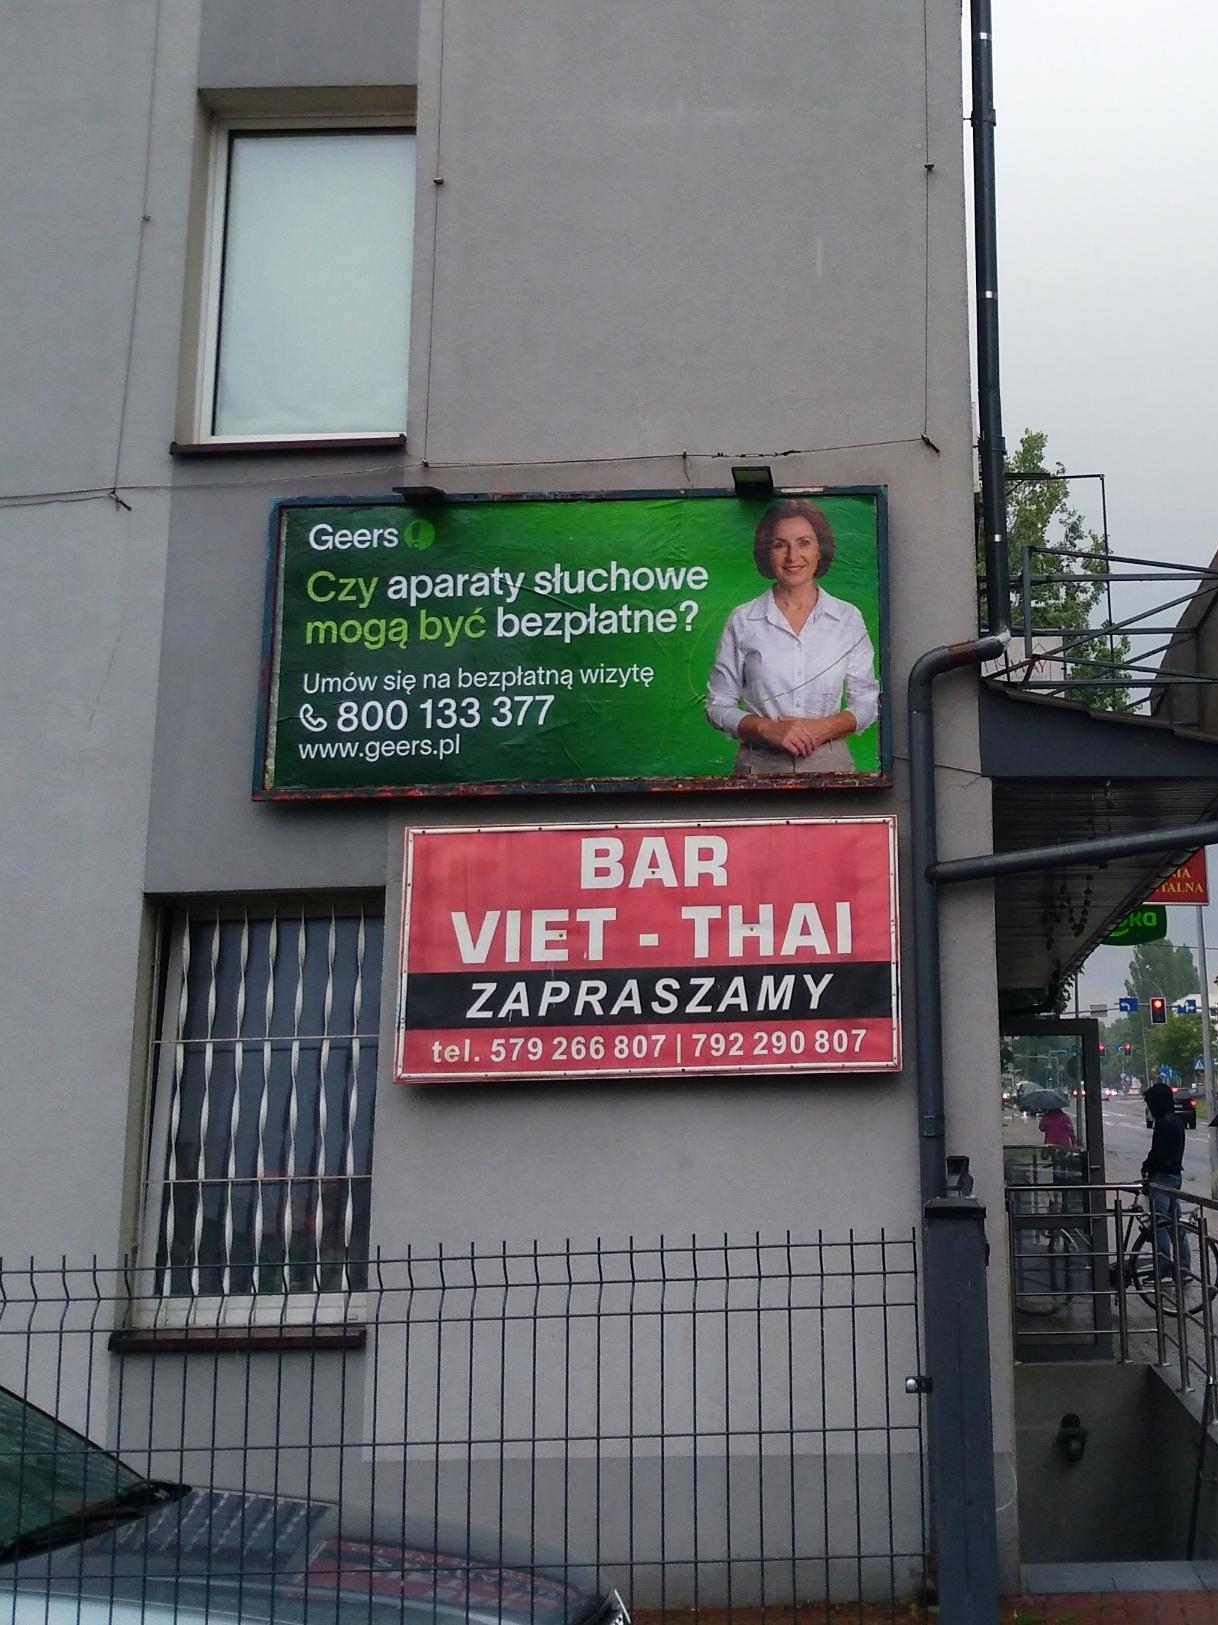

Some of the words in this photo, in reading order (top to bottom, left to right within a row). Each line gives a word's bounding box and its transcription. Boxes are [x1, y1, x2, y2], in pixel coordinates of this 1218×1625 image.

[309, 523, 399, 551] Geers
[306, 570, 379, 609] Czy
[387, 566, 525, 607] aparaty
[534, 560, 709, 595] słuchowe
[305, 616, 409, 650] mogą
[419, 607, 487, 648] być
[497, 600, 699, 644] bezpłatne?
[303, 671, 378, 694] Umów
[383, 669, 417, 695] się
[423, 672, 451, 689] na
[457, 665, 574, 692] bezpłatną
[579, 663, 655, 688] wizytę
[337, 699, 408, 732] 800
[419, 697, 481, 729] 133
[491, 694, 555, 727] 377
[298, 733, 460, 762] www.geers.pl
[579, 835, 729, 890] BAR
[1156, 882, 1204, 893] TALNA
[450, 906, 618, 964] VIET
[680, 901, 852, 960] THAI
[465, 973, 835, 1020] ZAPRASZAMY
[431, 1038, 480, 1064] tel.
[490, 1037, 543, 1062] 579
[552, 1035, 605, 1061] 266
[613, 1033, 667, 1059] 807
[692, 1030, 744, 1058] 792
[753, 1030, 806, 1056] 290
[814, 1028, 868, 1054] 807
